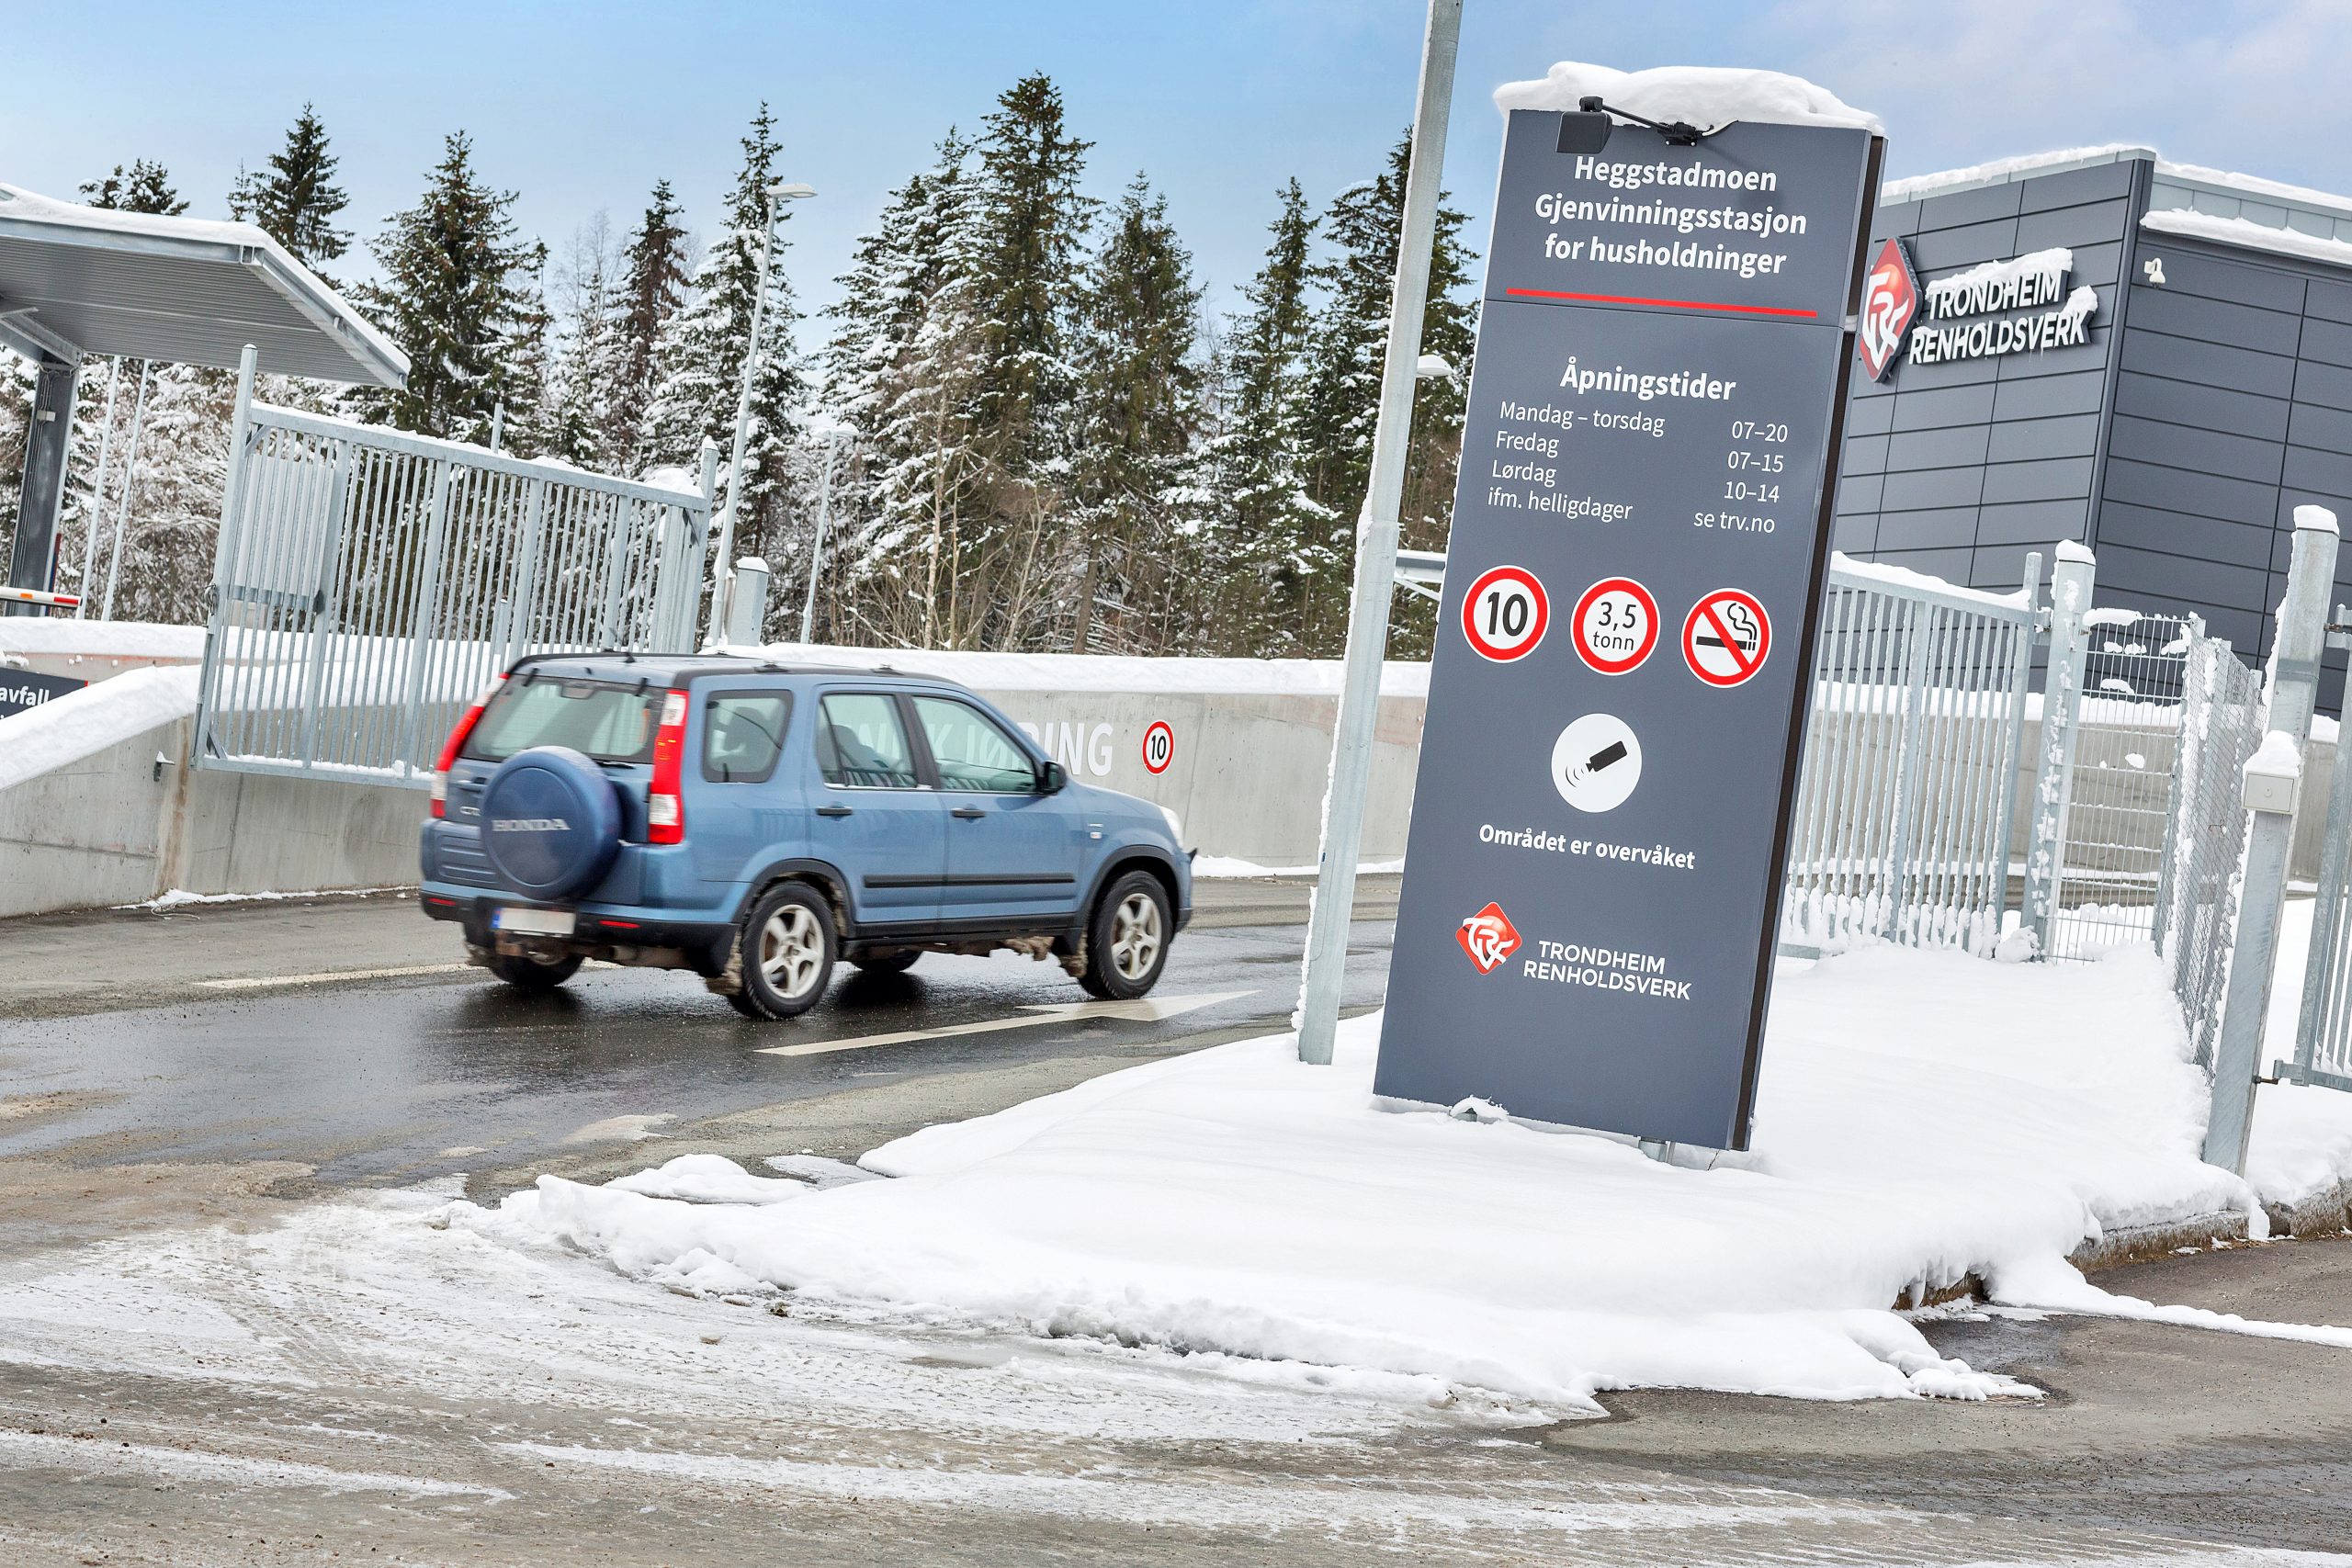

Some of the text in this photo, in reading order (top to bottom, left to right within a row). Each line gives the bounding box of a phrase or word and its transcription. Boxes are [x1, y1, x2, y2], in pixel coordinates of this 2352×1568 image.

[1574, 155, 1777, 192] Heggstadmoen
[1535, 193, 1807, 239] Gjenvinningsstasjon
[1544, 232, 1788, 279] for husholdninger
[1928, 270, 2064, 321] TRONDHEIM
[1908, 310, 2087, 366] RENHOLDSVERK
[1559, 355, 1737, 401] Åpningstider
[1499, 400, 1575, 430] Mandag
[1592, 410, 1666, 438] torsdag
[1496, 430, 1560, 458] Fredag
[1492, 459, 1557, 488] Lørdag
[1487, 486, 1775, 534] ifm. helligdager se trv.no
[1487, 592, 1529, 637] 10
[1598, 601, 1637, 632] 3,5
[1592, 631, 1634, 651] tonn
[1151, 735, 1166, 760] 10
[1479, 823, 1696, 870] Området er overvåket
[1538, 940, 1666, 976] TRONDHEIM
[1523, 959, 1692, 1000] RENHOLDSVERK
